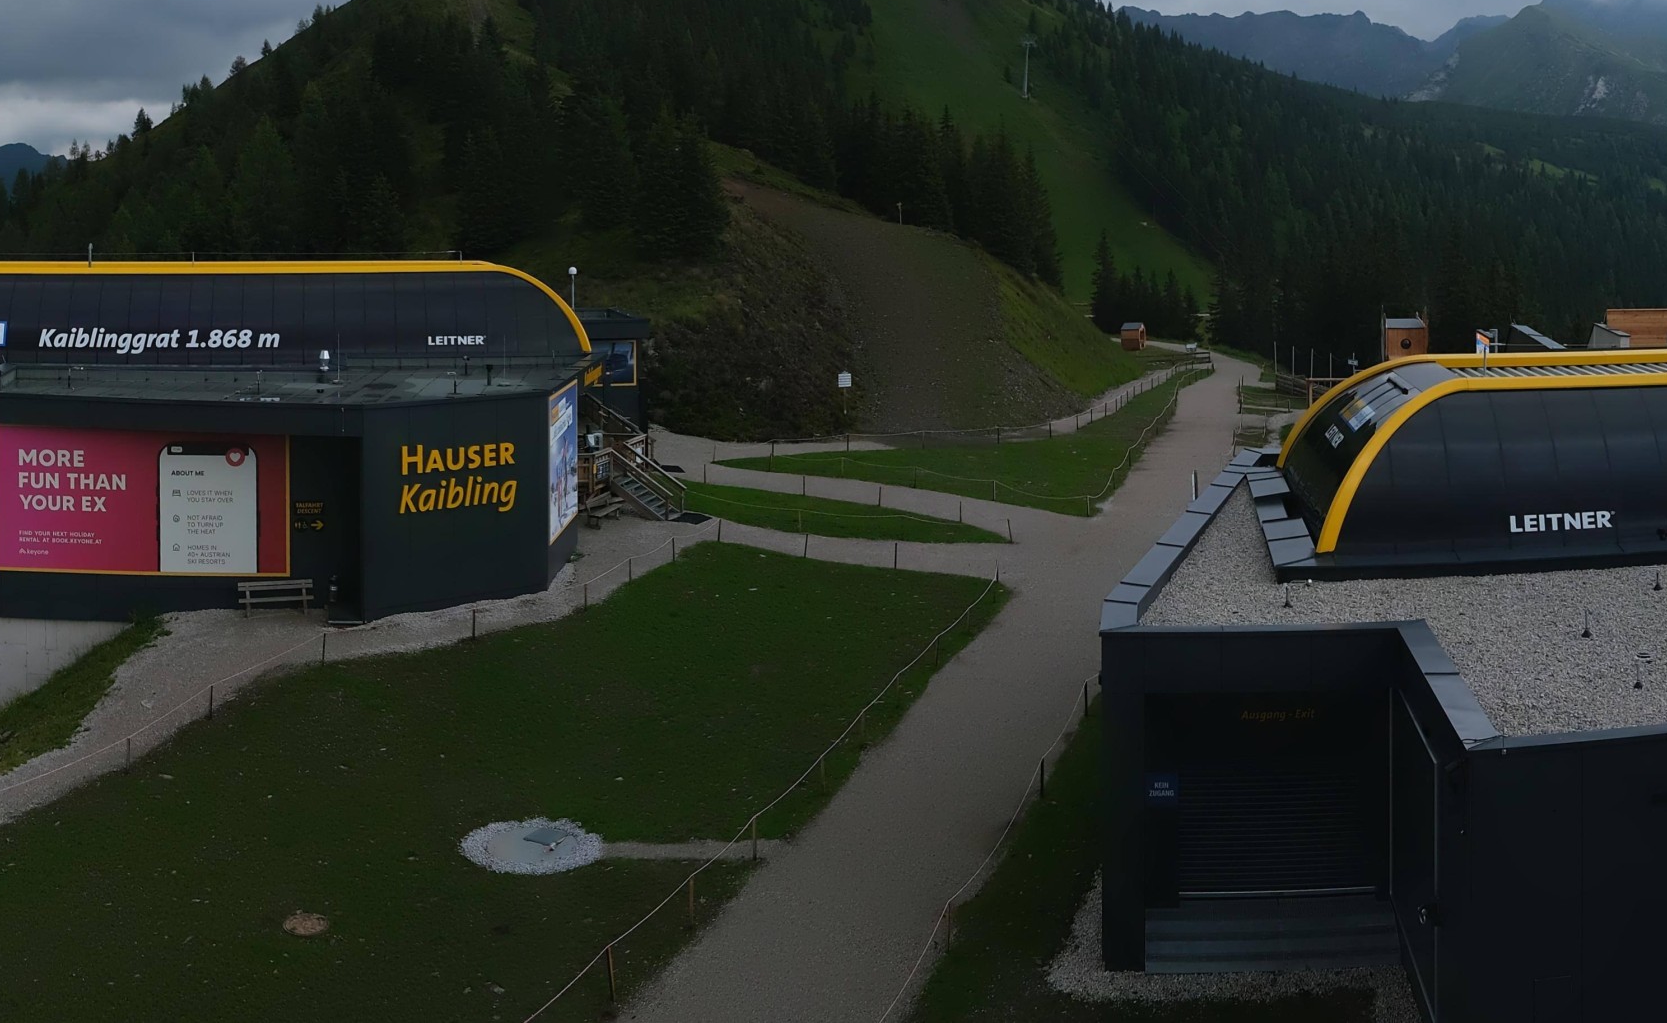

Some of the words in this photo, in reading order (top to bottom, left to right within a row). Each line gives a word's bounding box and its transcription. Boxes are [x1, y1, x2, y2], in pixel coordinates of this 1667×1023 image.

[38, 327, 181, 354] Kaiblinggrat
[185, 329, 253, 348] 1.868
[257, 332, 280, 348] m
[427, 335, 485, 346] LEITNER
[18, 448, 85, 467] MORE
[401, 442, 515, 475] HAUSER
[18, 472, 59, 489] FUN
[66, 472, 126, 490] THAN
[20, 494, 75, 511] YOUR
[81, 496, 106, 512] EX
[399, 475, 517, 514] Kaibling
[1509, 510, 1613, 533] LEITNER
[26, 548, 49, 556] keyone
[1241, 709, 1286, 722] Ausgang
[1295, 707, 1316, 719] Exit
[1149, 789, 1175, 797] ZUGANG
[1154, 781, 1169, 789] KEIN
